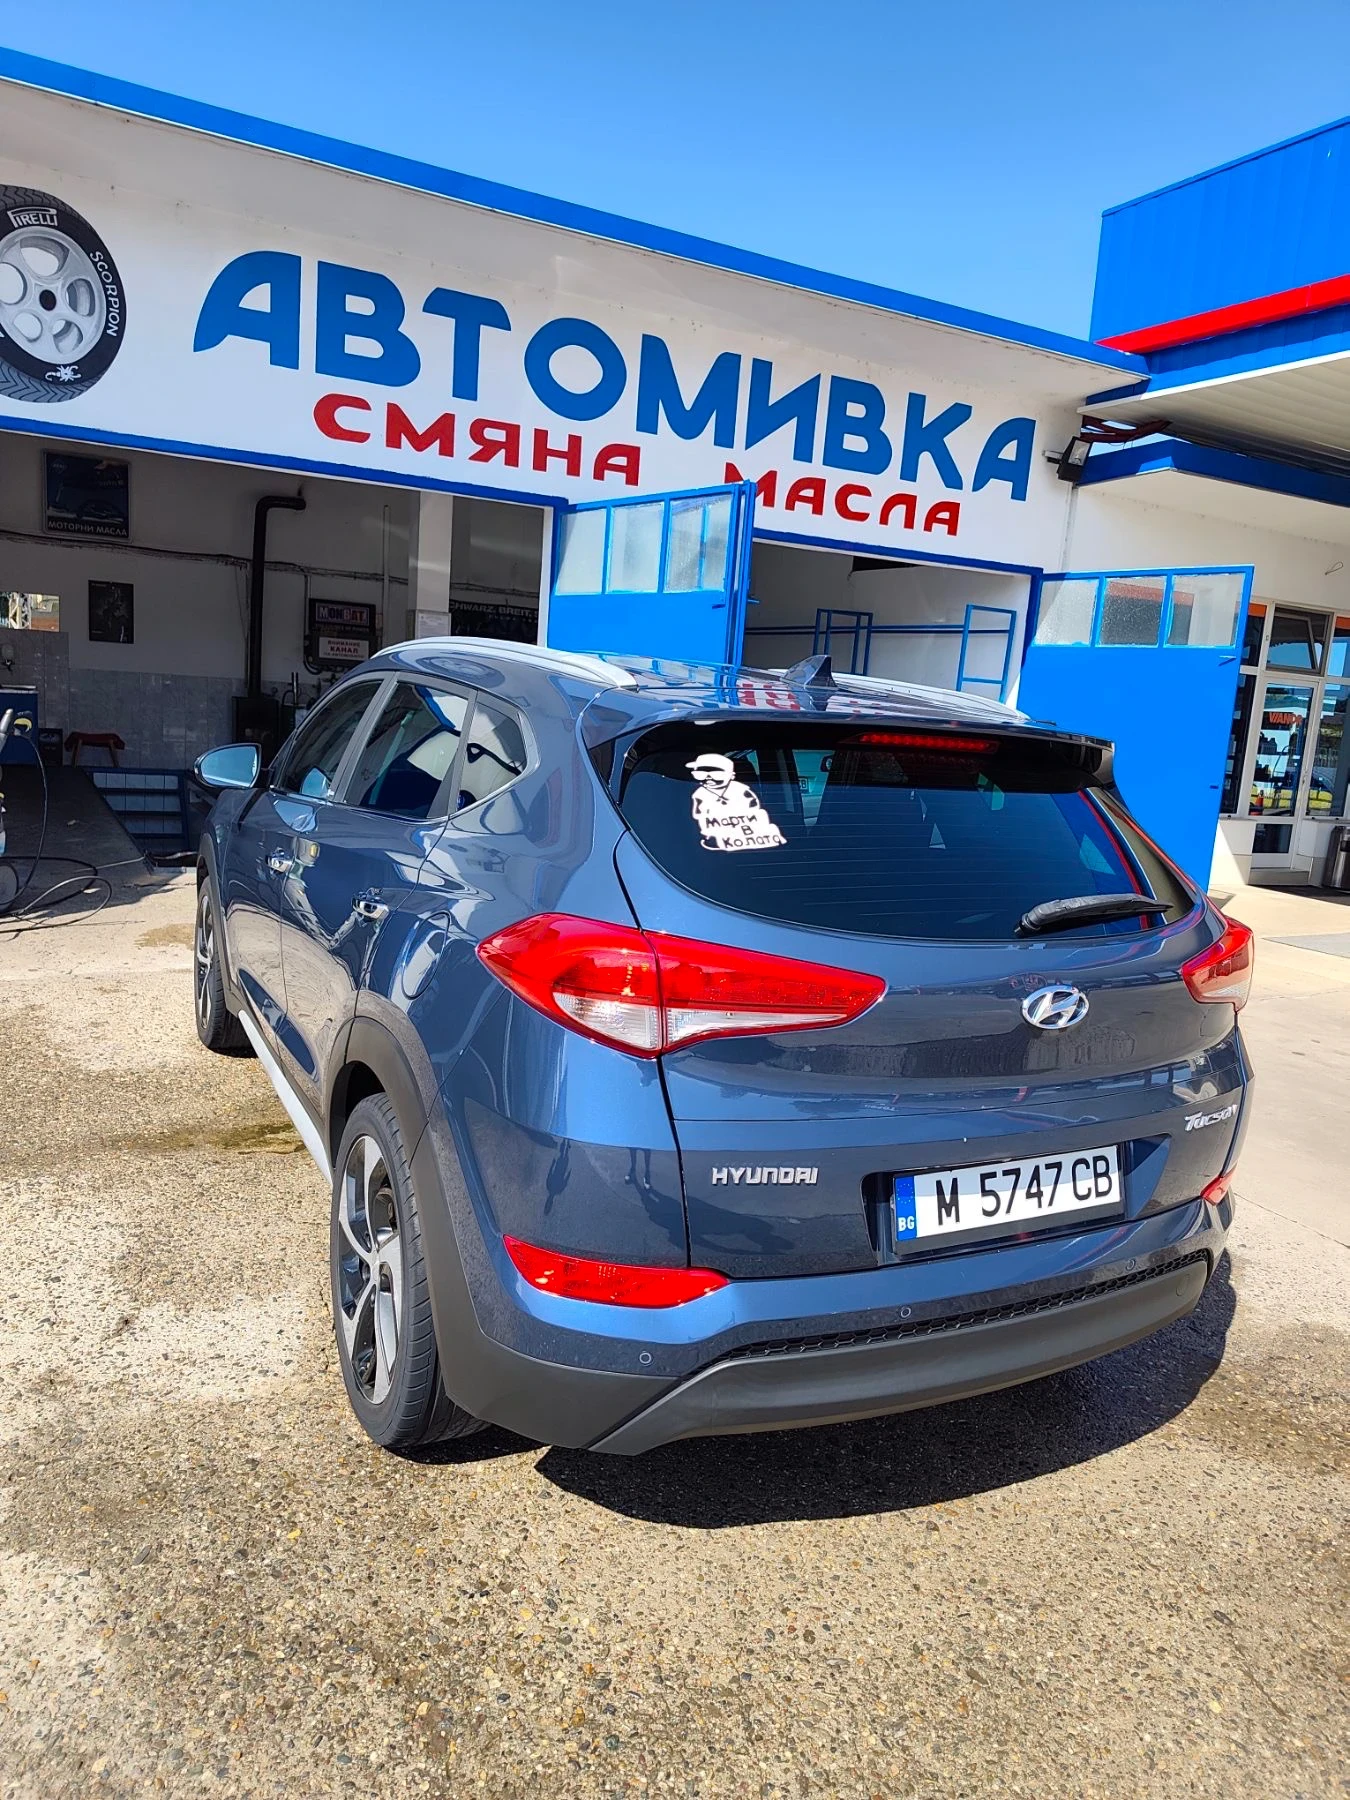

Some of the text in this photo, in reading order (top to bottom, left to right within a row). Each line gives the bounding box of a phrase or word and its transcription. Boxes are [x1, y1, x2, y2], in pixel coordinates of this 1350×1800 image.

[7, 206, 57, 228] PIRELLI
[89, 250, 120, 337] SCORPION
[193, 250, 1036, 501] АВТОМИВКА
[313, 393, 641, 486] СМЯНА
[48, 520, 128, 536] МОТОРНИ МАСЛА
[330, 646, 359, 655] КАНАЛ
[706, 815, 757, 828] Марти
[712, 1166, 818, 1185] HYUNDAI
[935, 1155, 1112, 1226] M 5747 CB
[898, 1216, 915, 1232] BG
